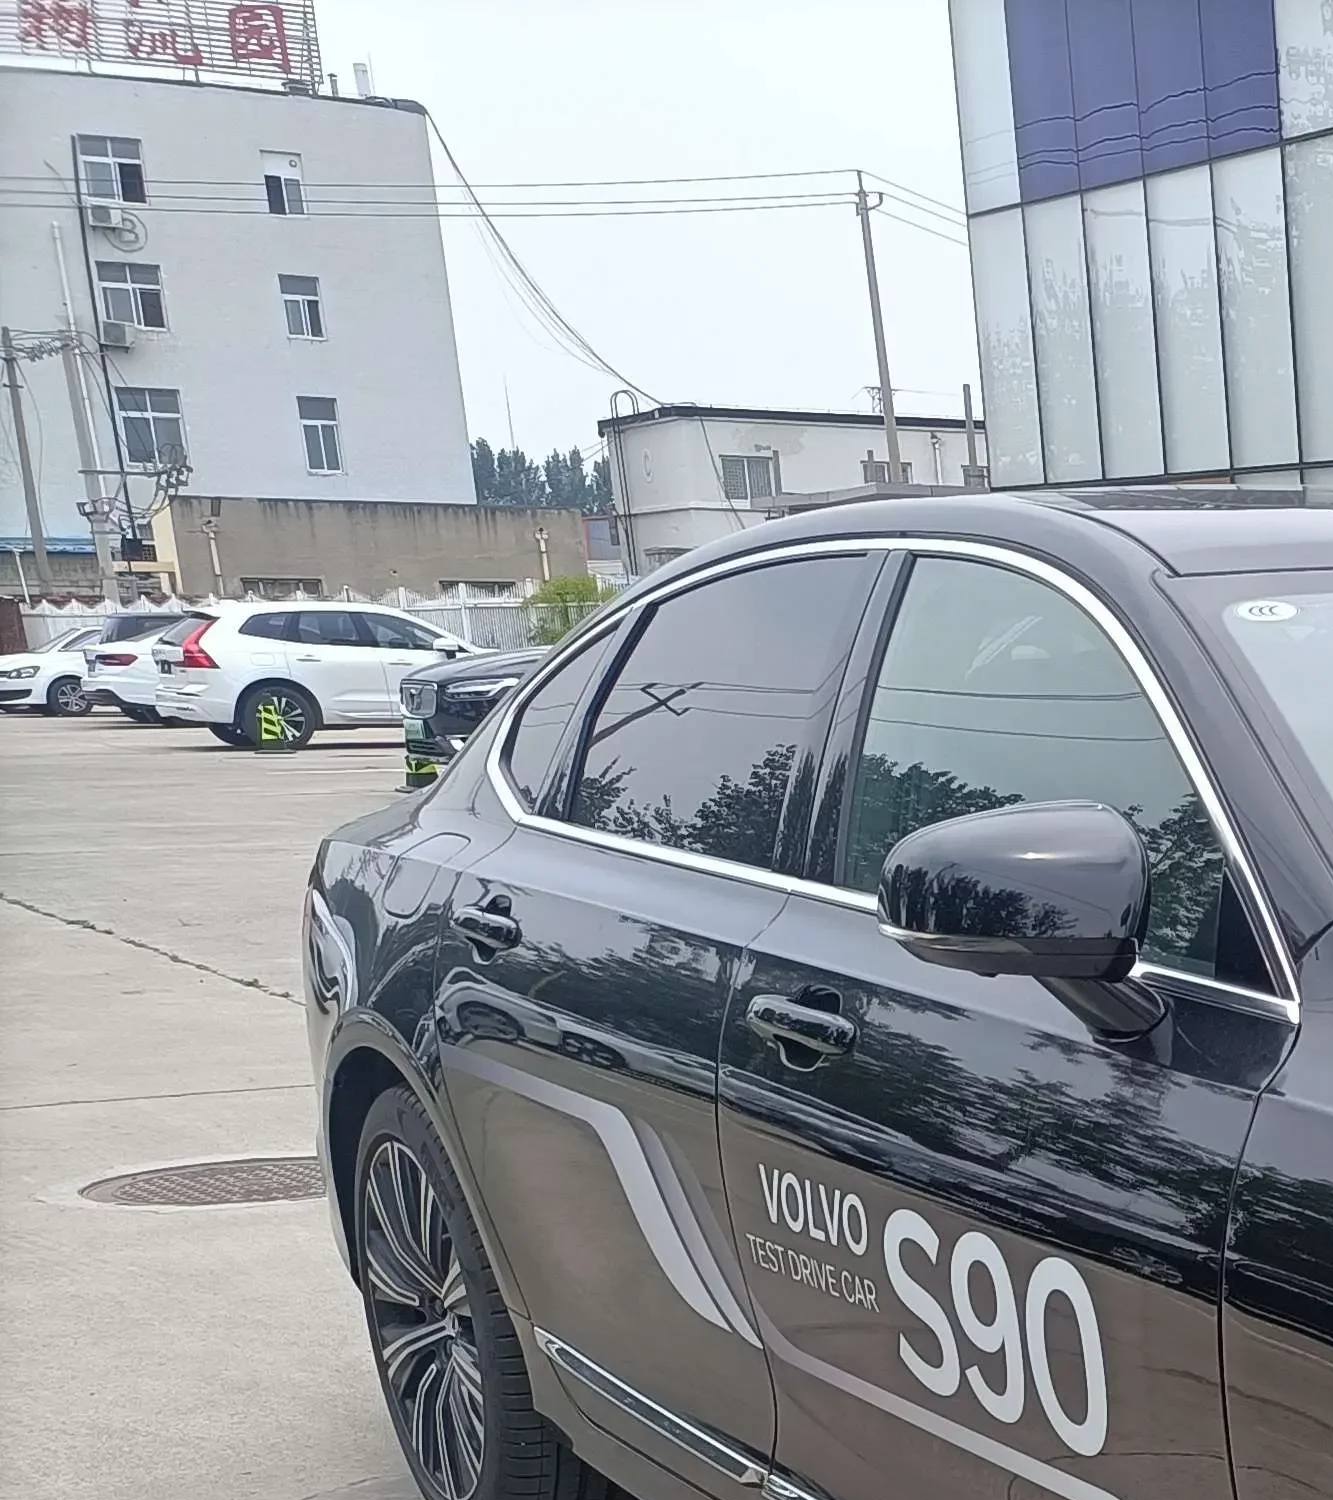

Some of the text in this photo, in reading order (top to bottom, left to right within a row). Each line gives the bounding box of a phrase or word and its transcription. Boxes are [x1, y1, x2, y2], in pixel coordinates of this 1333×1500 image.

[758, 1163, 868, 1256] VOLVO
[745, 1233, 880, 1313] TEST DRIVE CAR
[883, 1208, 1108, 1457] S90
